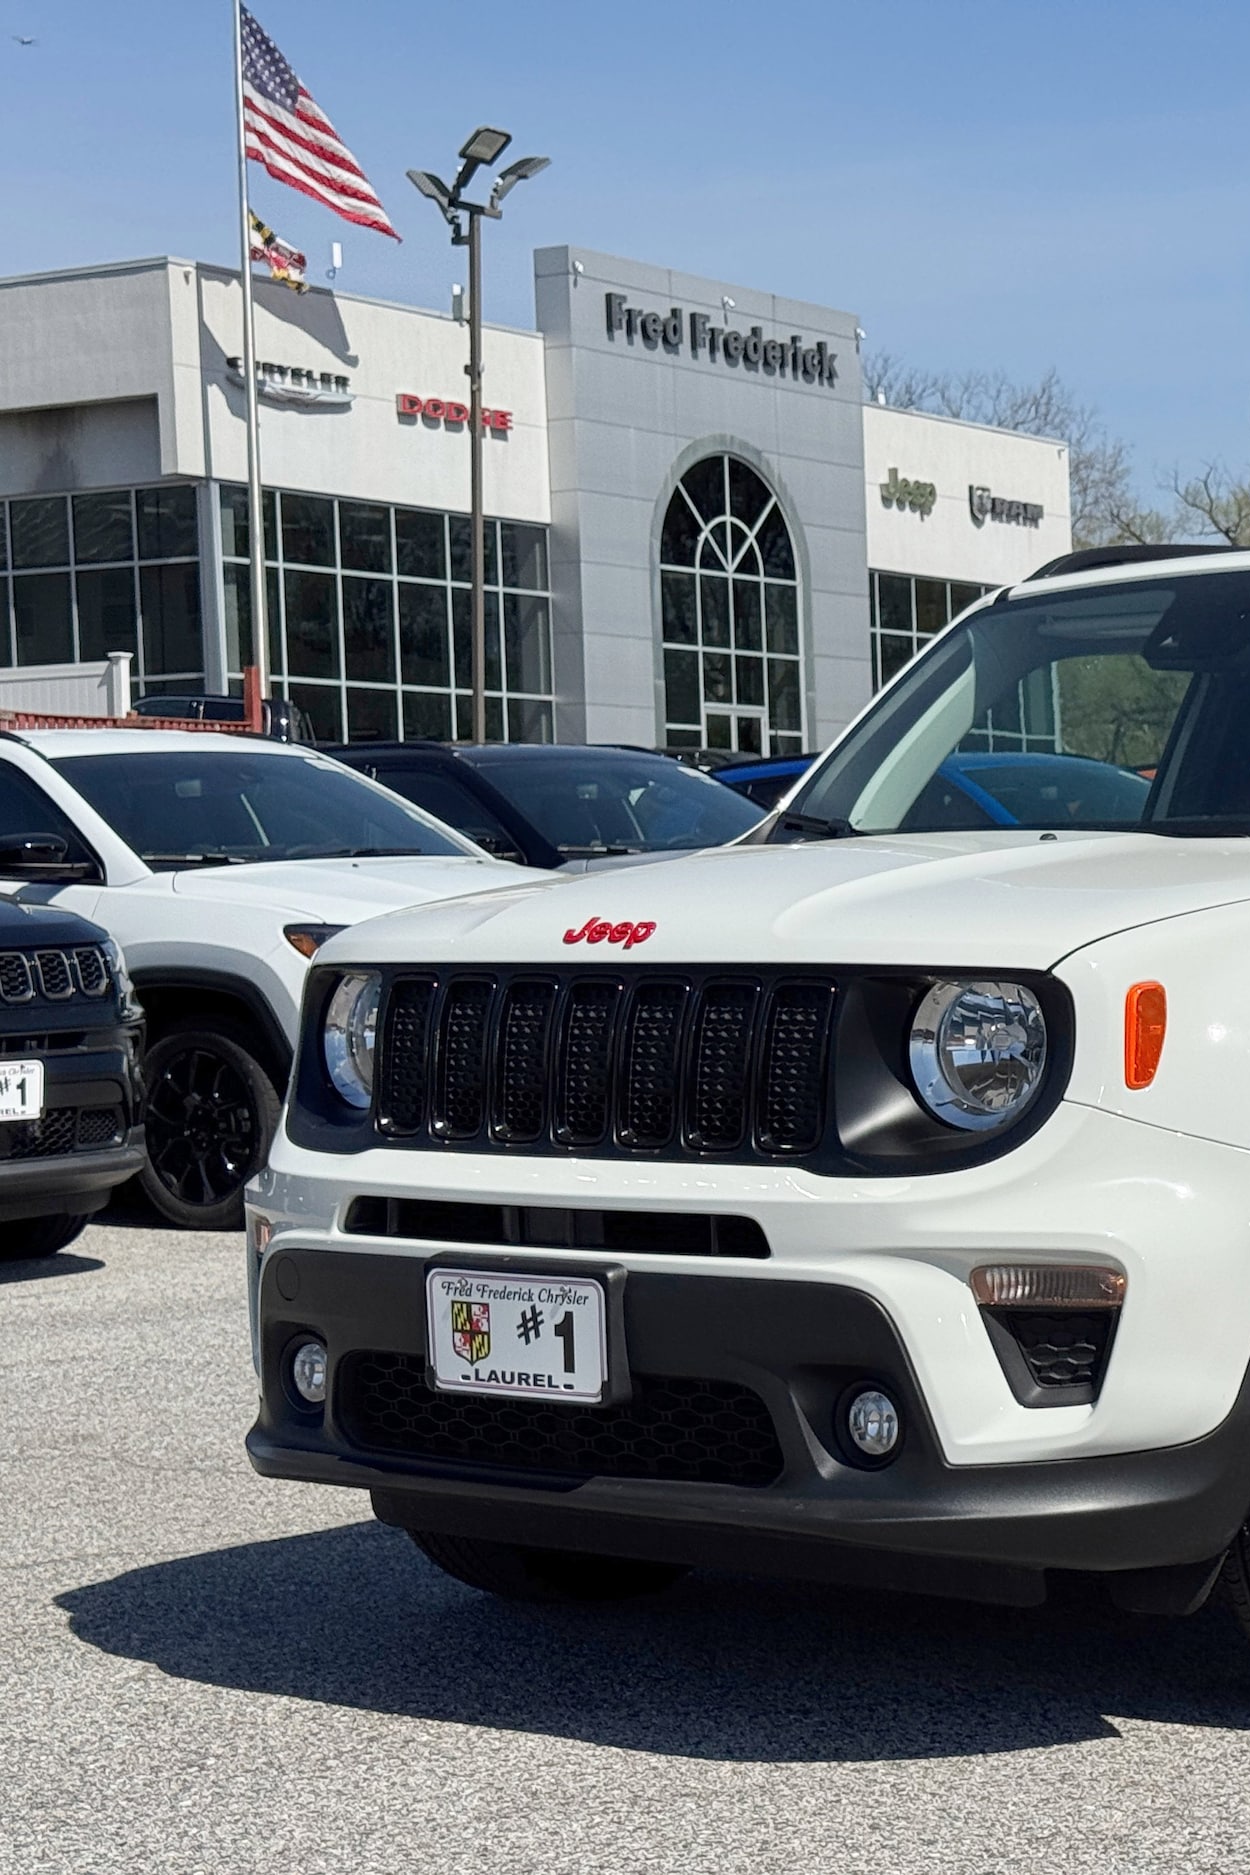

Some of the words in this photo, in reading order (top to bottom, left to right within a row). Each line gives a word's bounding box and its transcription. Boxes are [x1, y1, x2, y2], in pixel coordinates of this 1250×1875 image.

[605, 292, 683, 346] Fred
[690, 311, 839, 380] Frederick
[225, 357, 350, 388] CRYSLER
[879, 467, 937, 515] Jeep
[562, 916, 657, 950] Jeep
[441, 1280, 473, 1297] Fred
[475, 1283, 535, 1303] Frederick
[537, 1286, 590, 1307] Chrysler
[474, 1368, 560, 1390] LAUREL
